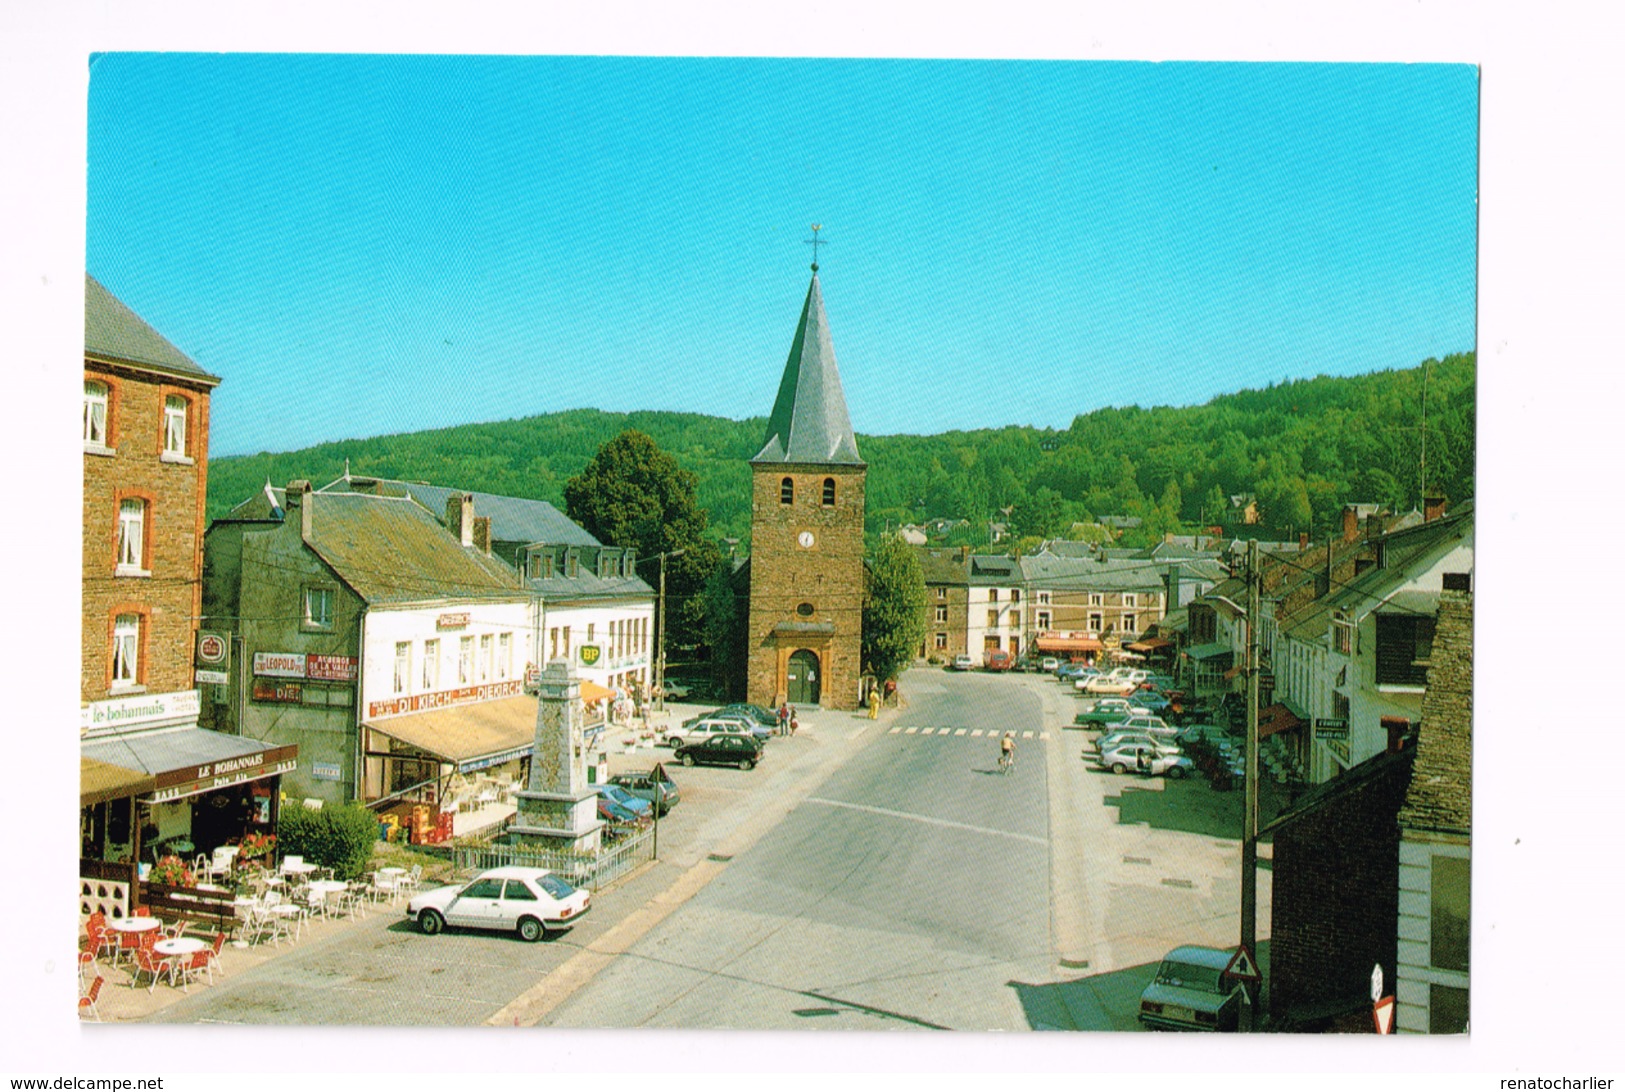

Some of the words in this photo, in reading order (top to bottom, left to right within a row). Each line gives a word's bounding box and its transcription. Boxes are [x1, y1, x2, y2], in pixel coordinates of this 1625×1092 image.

[266, 656, 295, 670] LEOPOLD
[583, 648, 599, 660] BP
[477, 680, 522, 700] DIEKIRCH
[93, 706, 104, 722] le
[107, 699, 165, 721] bohannais
[198, 766, 211, 778] LE
[214, 753, 264, 775] BOHANNAIS
[155, 787, 180, 801] BASS
[277, 760, 297, 772] BASS
